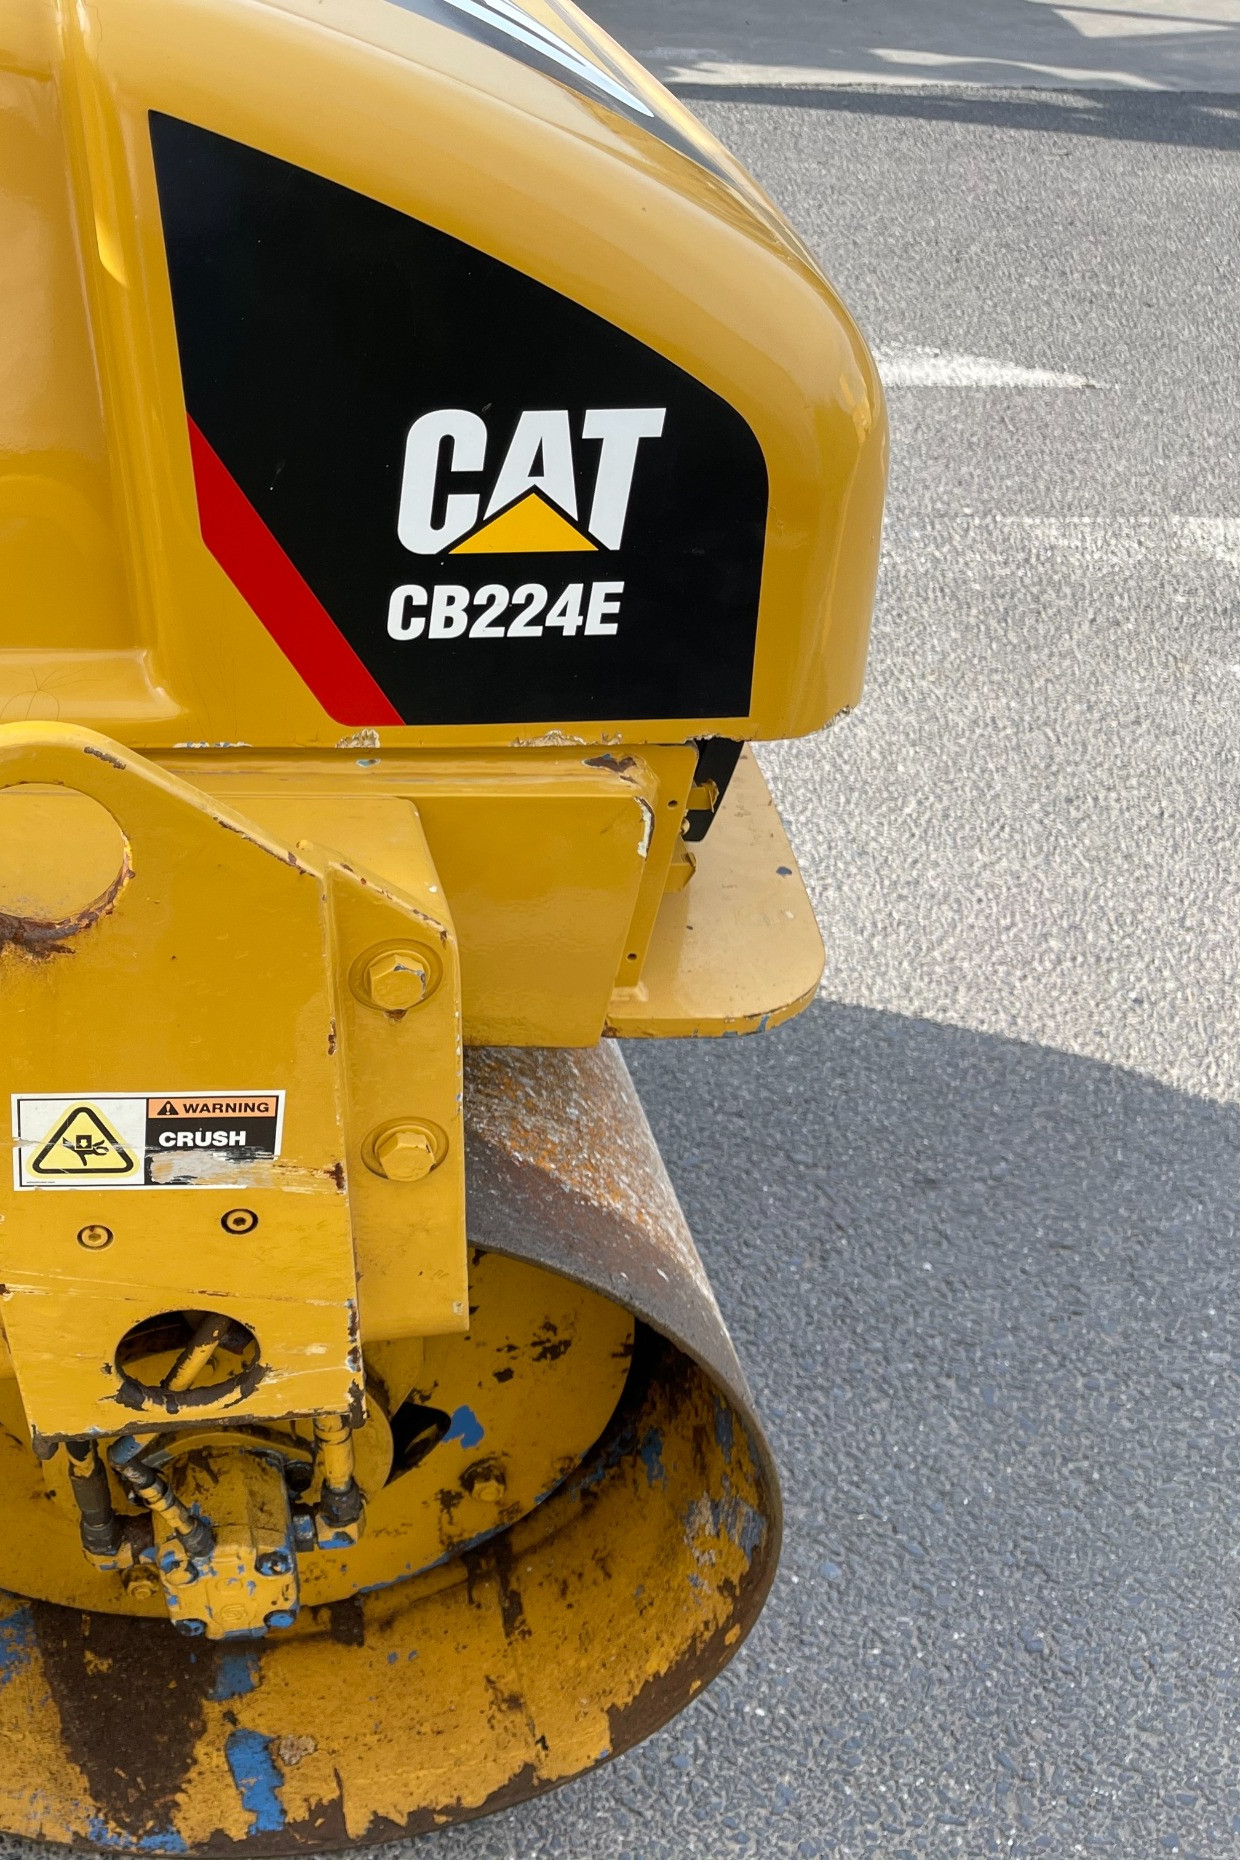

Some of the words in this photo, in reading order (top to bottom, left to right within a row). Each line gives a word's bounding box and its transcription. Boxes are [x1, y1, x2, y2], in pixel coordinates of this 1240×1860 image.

[397, 407, 667, 555] CAT
[386, 580, 626, 642] CB224E
[182, 1102, 270, 1114] WARNING
[158, 1130, 247, 1148] CRUSH
